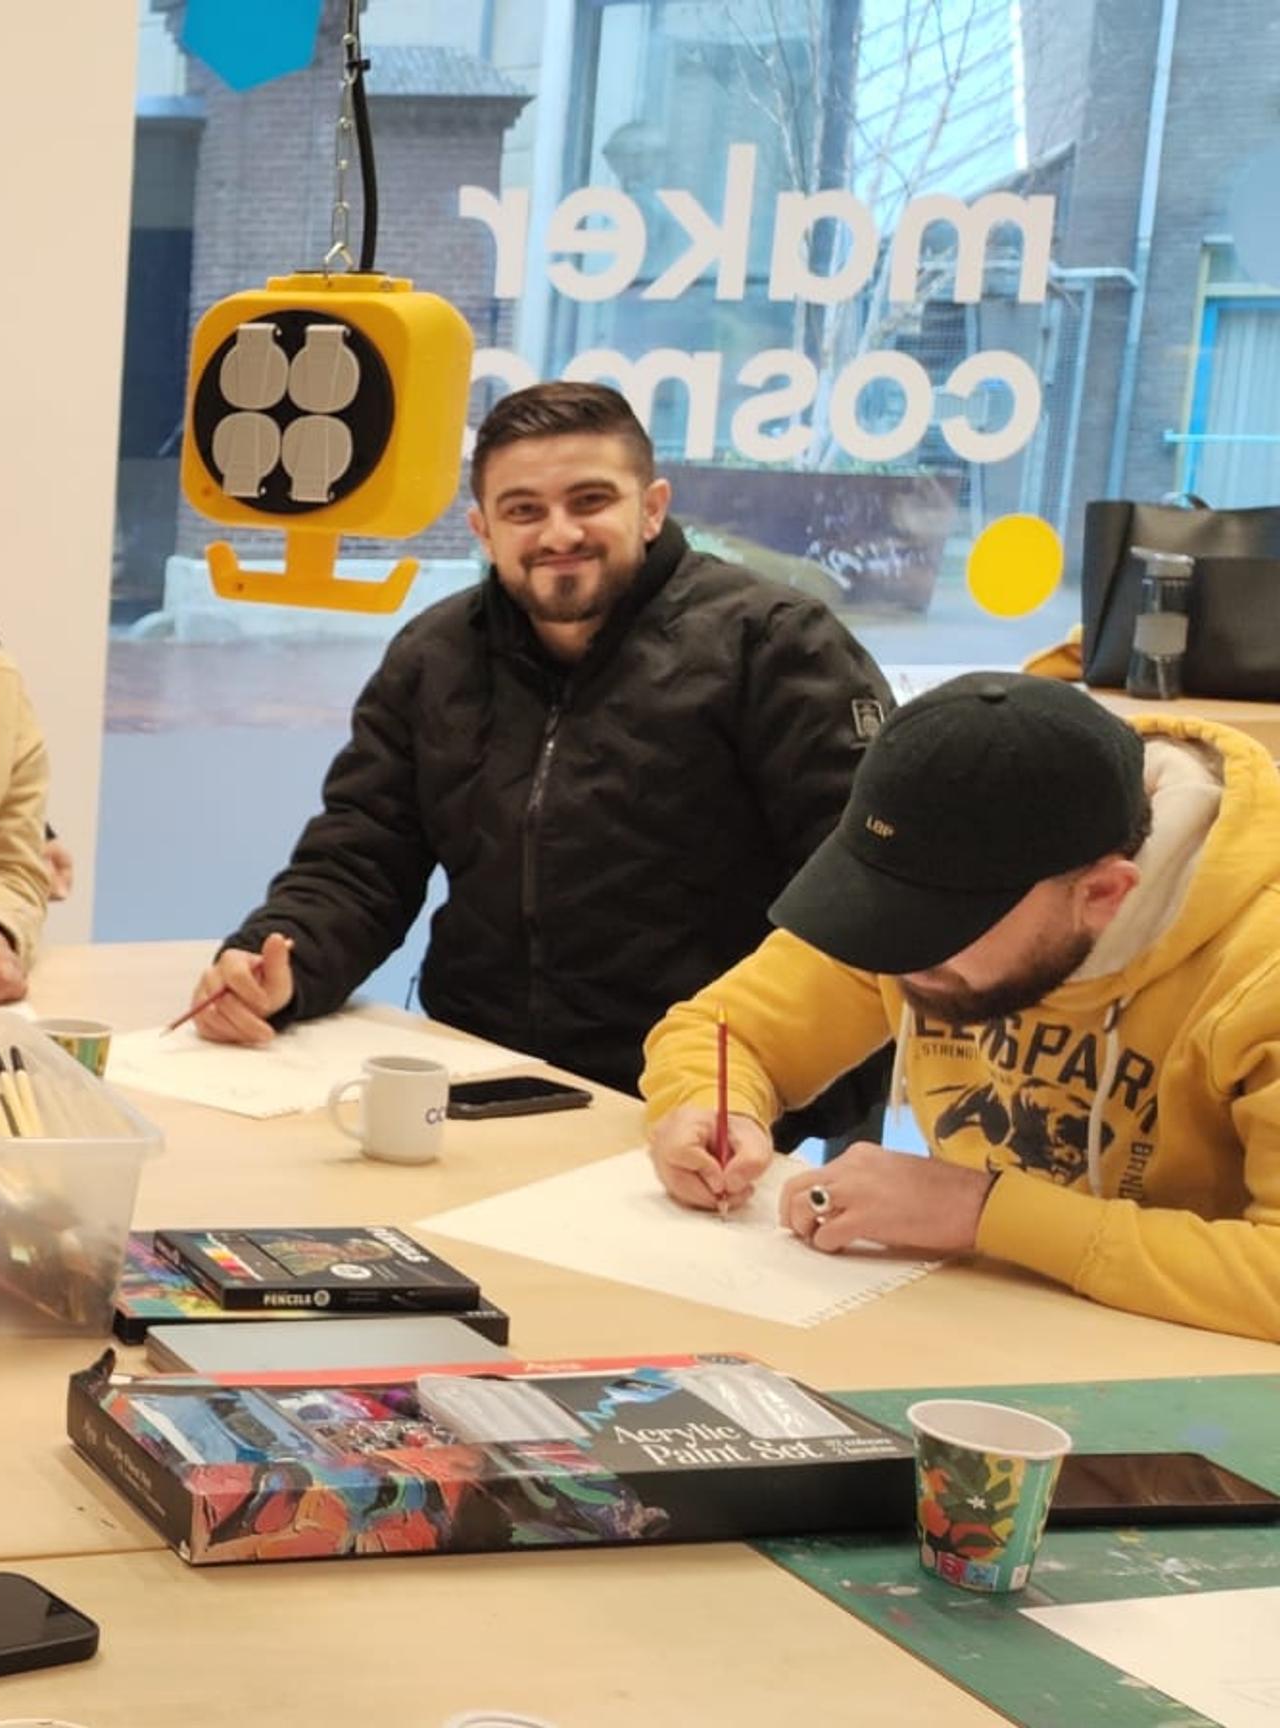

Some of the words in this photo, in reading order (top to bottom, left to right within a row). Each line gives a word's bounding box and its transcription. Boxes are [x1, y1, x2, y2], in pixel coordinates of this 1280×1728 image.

[613, 1422, 740, 1448] Acrylic
[642, 1443, 751, 1466] Paint
[748, 1439, 825, 1461] Set
